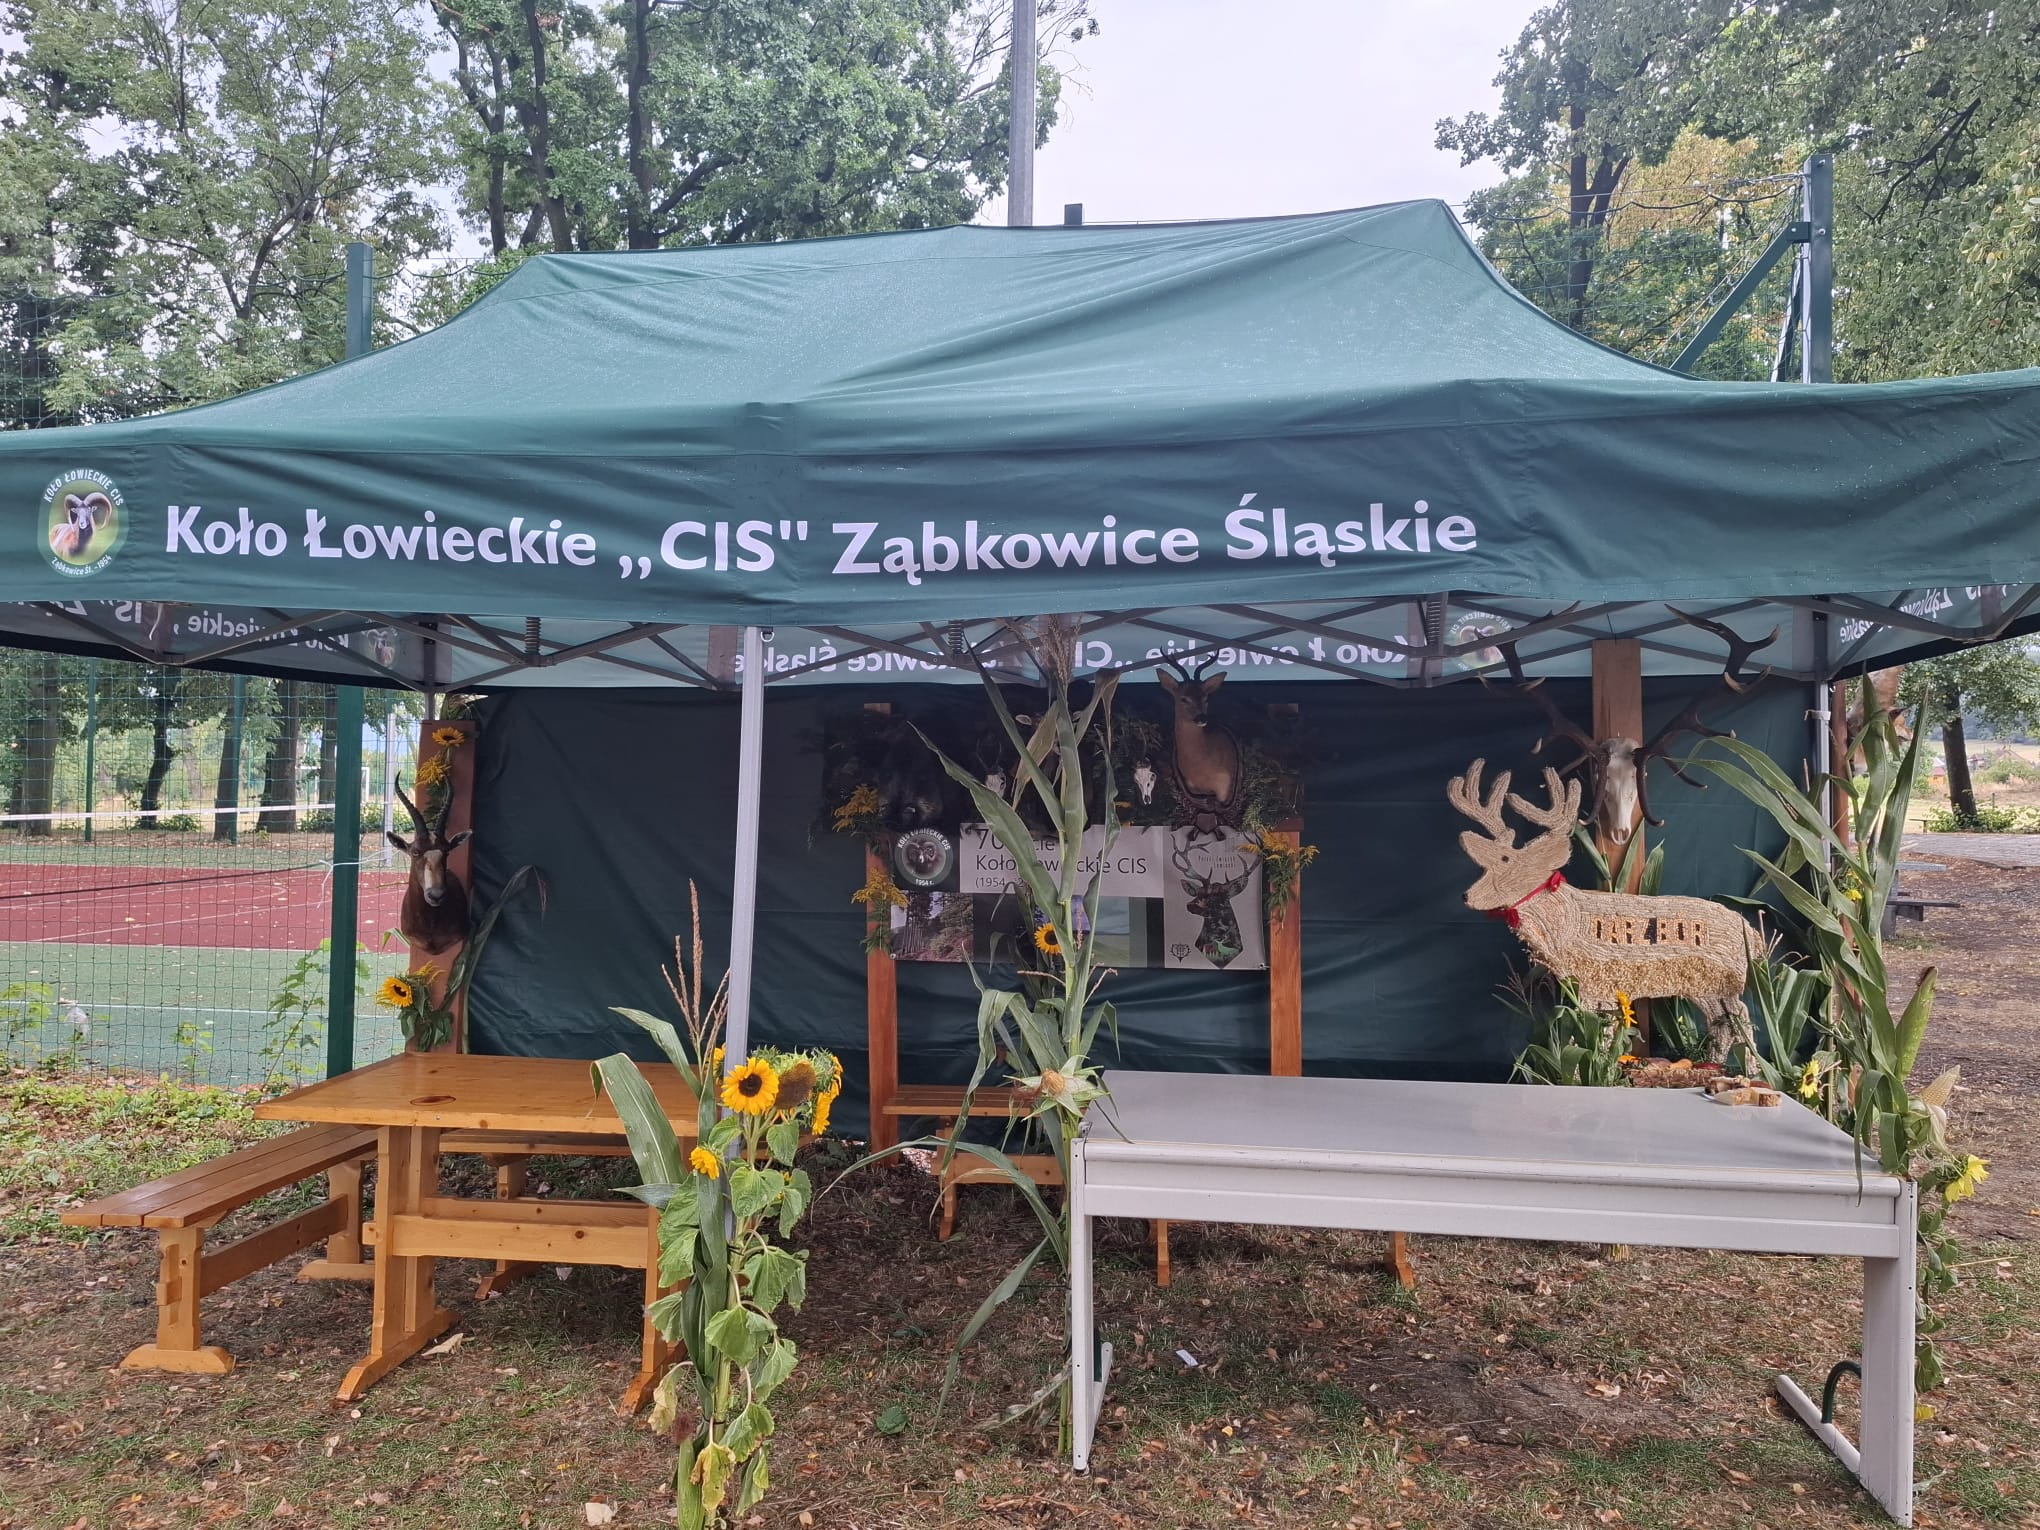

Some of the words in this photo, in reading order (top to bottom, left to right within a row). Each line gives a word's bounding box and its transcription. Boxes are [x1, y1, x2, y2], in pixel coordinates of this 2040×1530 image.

[43, 478, 62, 503] KOŁO
[64, 468, 112, 490] ŁOWIECKIE
[110, 487, 124, 506] CIS
[166, 505, 287, 557] Koło
[304, 508, 597, 566] Łowieckie
[832, 515, 1199, 585] Ząbkowice
[1225, 493, 1477, 567] Śląskie
[976, 854, 1017, 871] Koło
[1117, 857, 1147, 874] CIS
